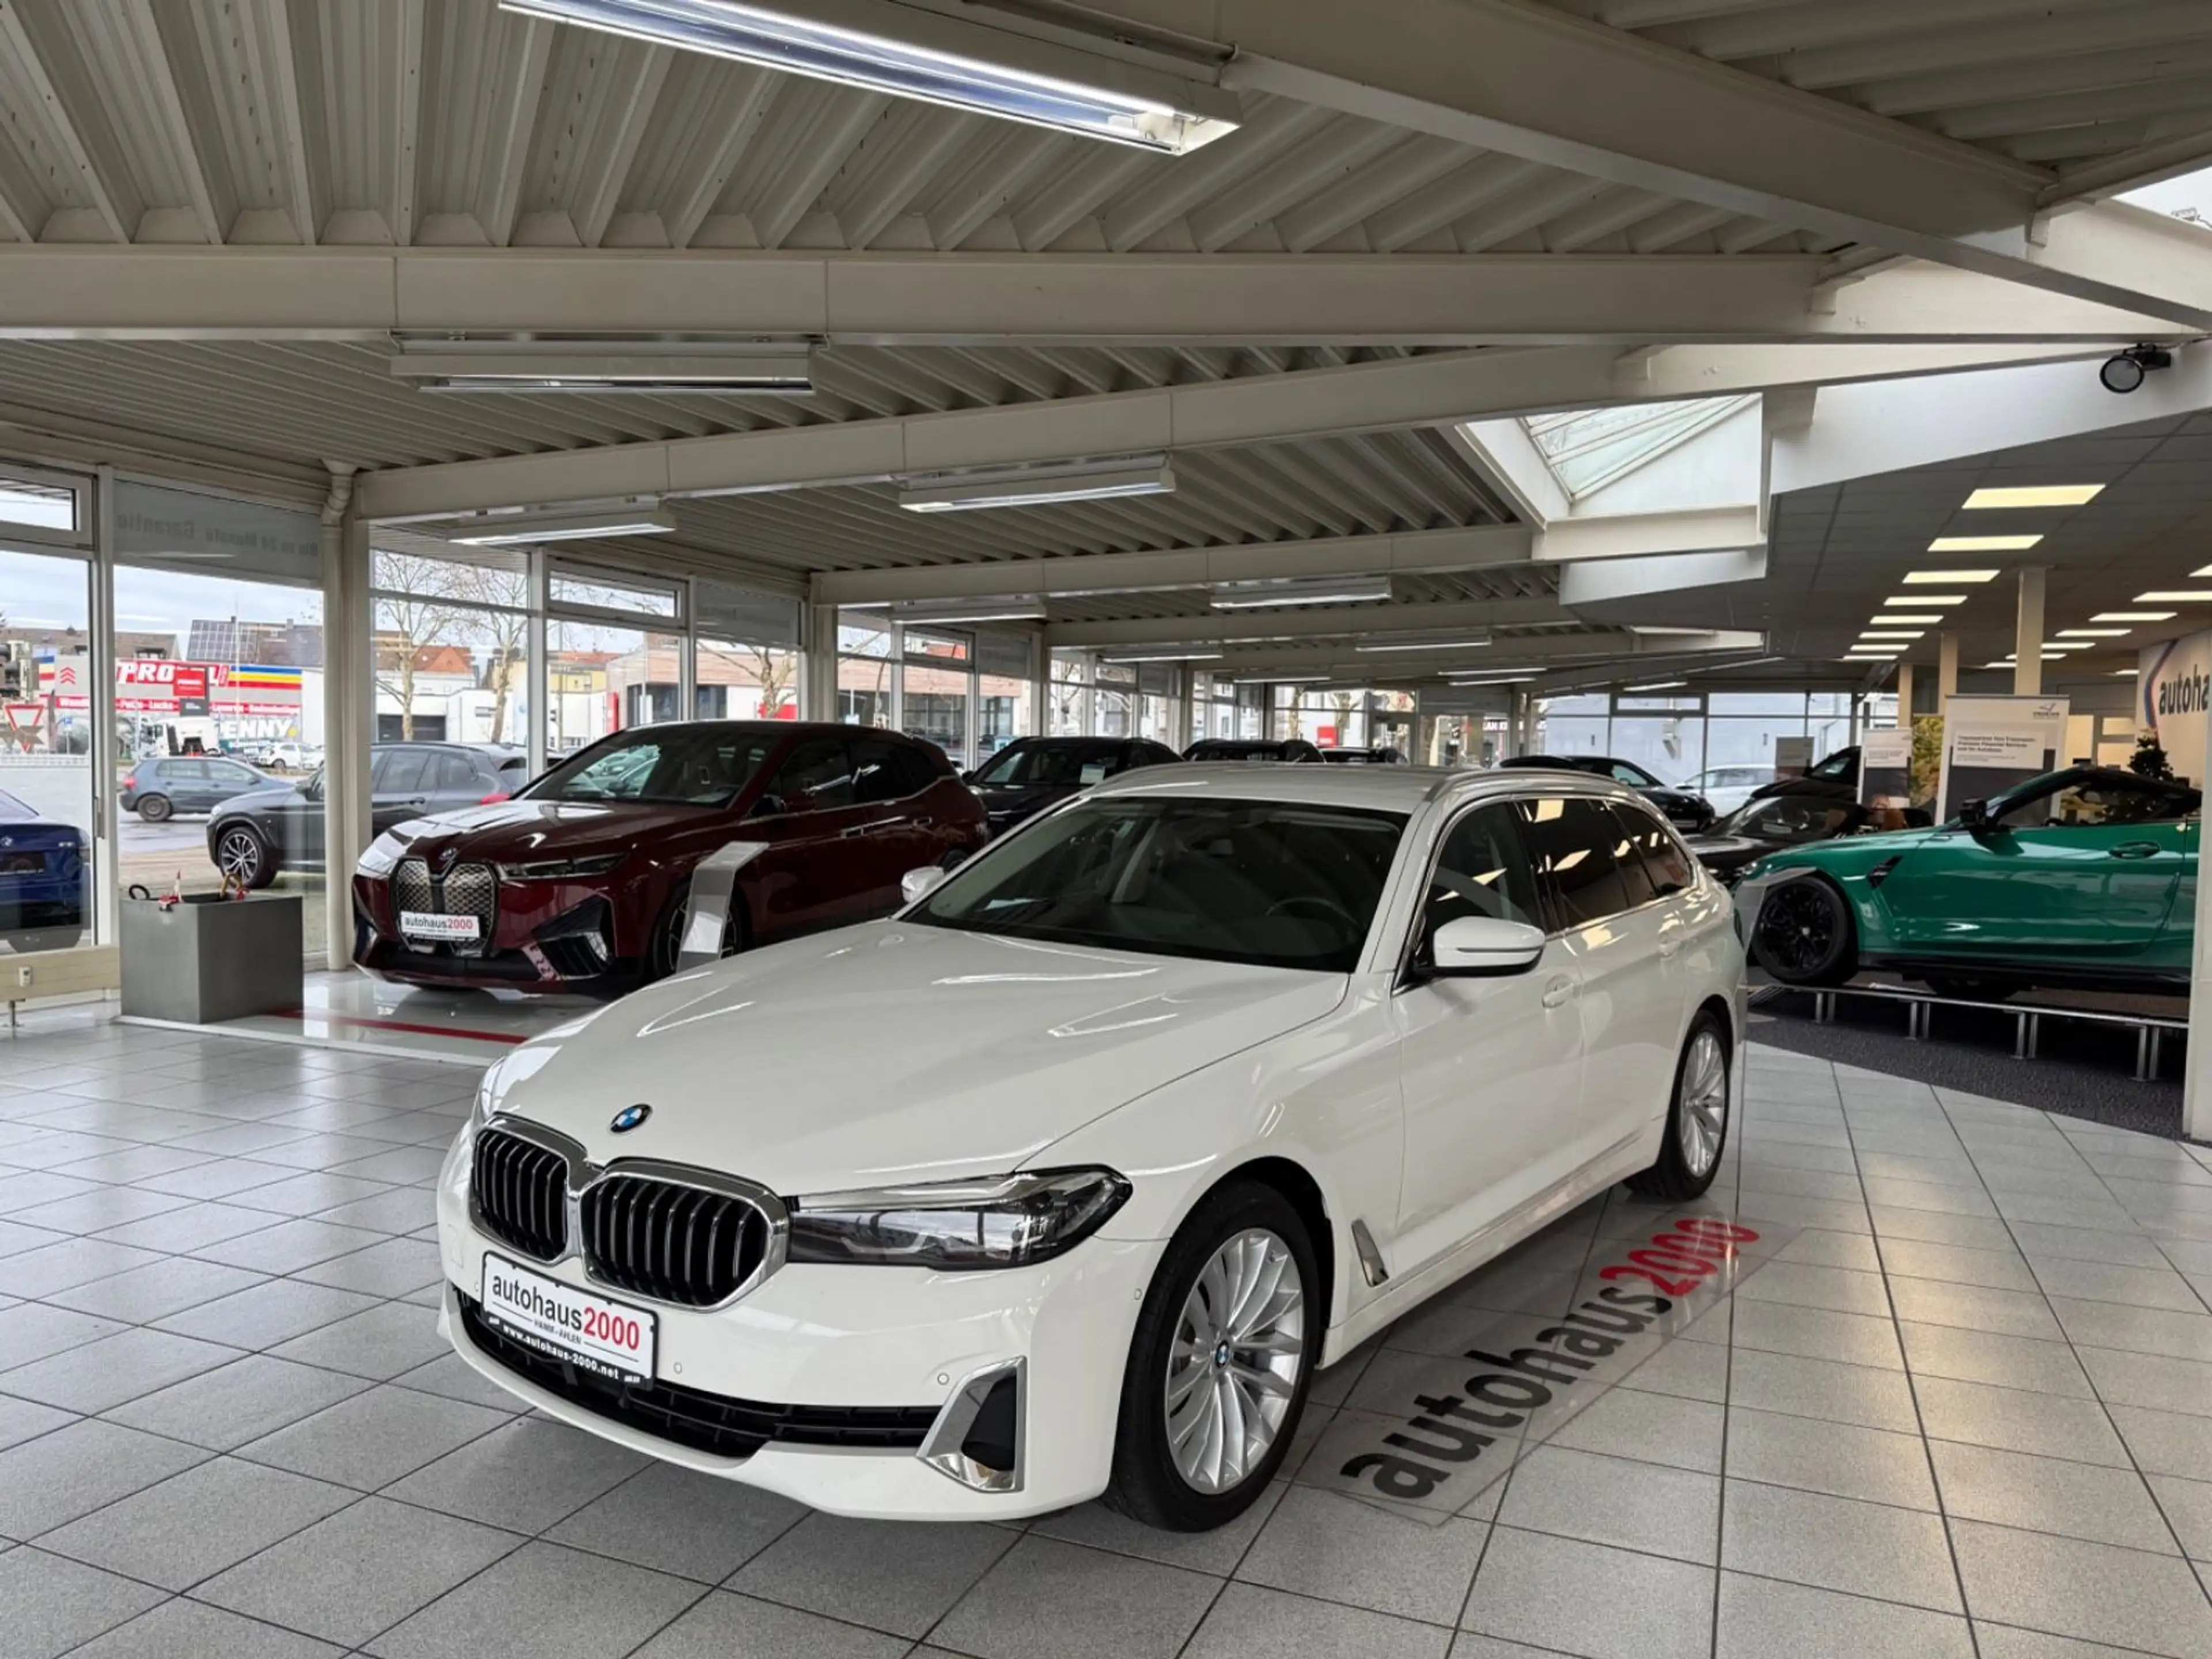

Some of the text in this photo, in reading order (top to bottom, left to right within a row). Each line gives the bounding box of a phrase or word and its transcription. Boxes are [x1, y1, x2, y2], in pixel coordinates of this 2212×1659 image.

[405, 916, 473, 929] autohaus2000
[493, 1275, 639, 1351] autohaus2000
[503, 1325, 619, 1380] www.autohaus-2000.net
[1340, 1218, 1760, 1498] autohaus2000
